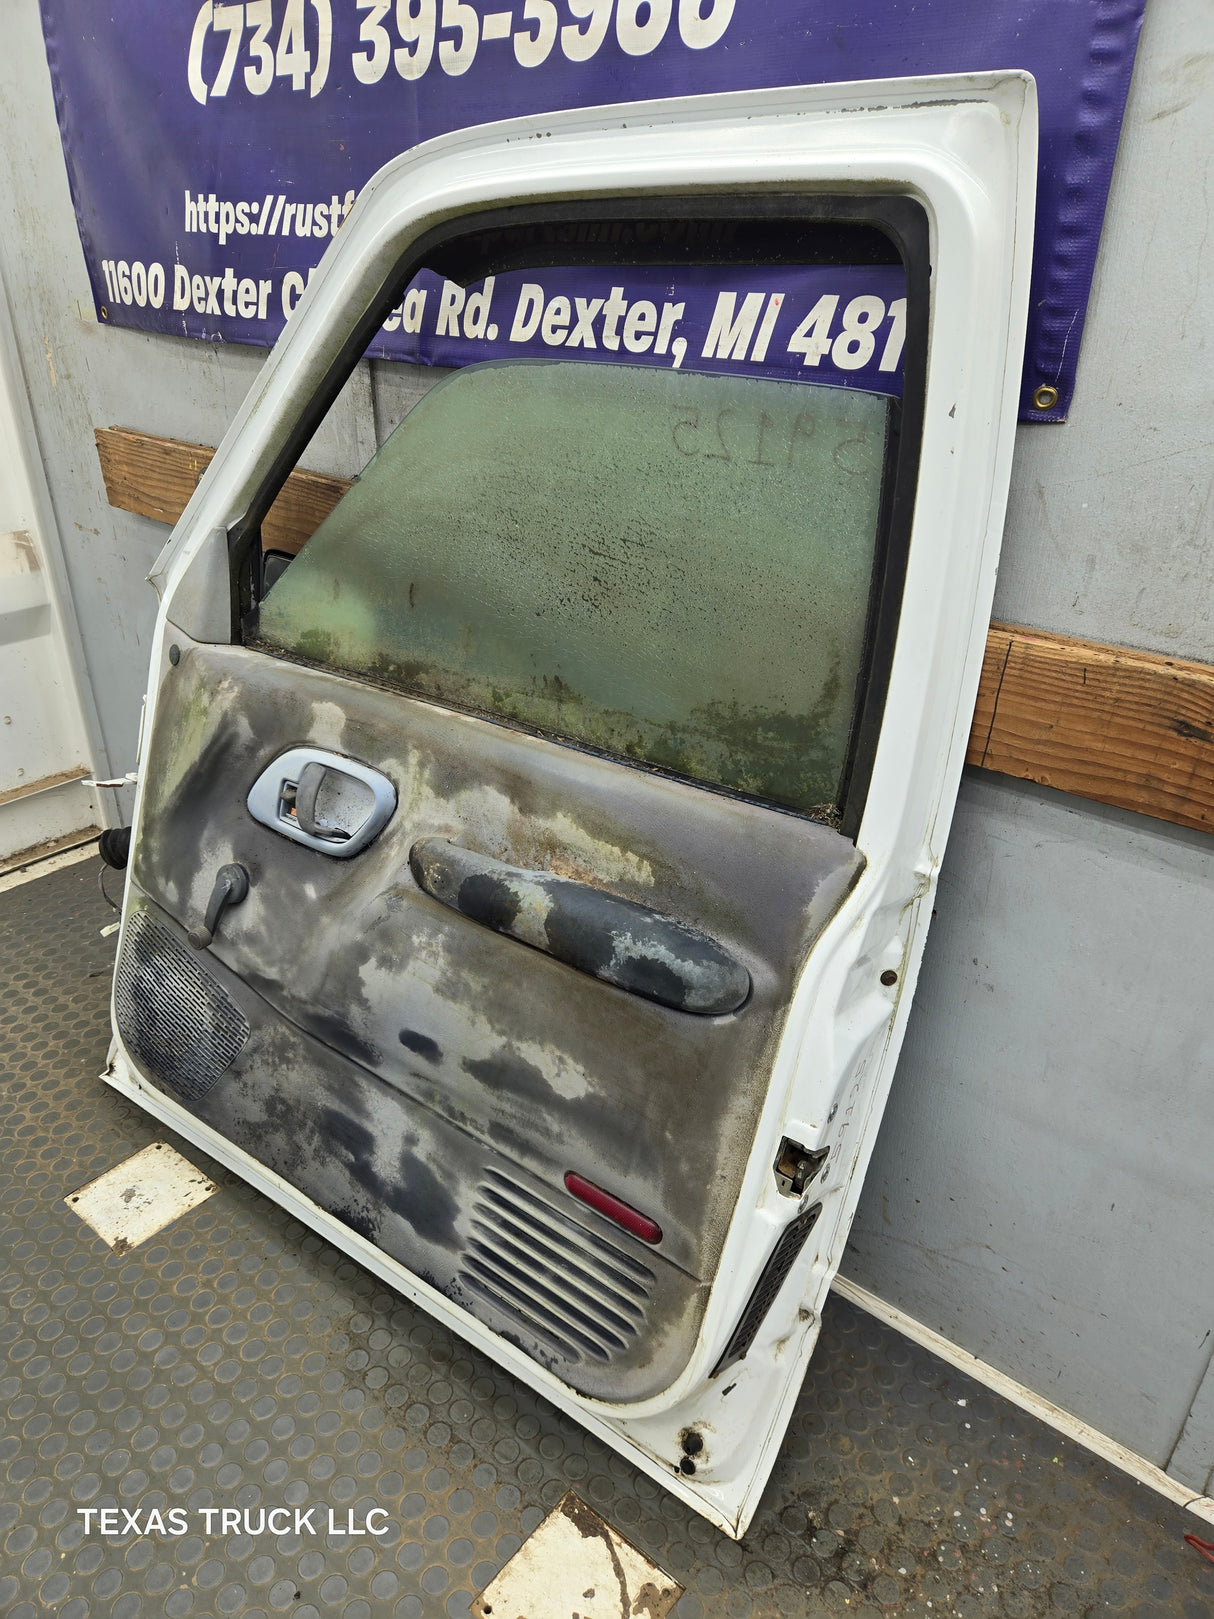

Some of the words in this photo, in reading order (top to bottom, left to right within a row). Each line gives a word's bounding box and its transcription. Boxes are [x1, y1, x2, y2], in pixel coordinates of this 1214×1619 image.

[187, 0, 332, 105] (734)
[101, 259, 165, 309] 11600
[173, 264, 272, 319] Dexter
[435, 275, 498, 341] Rd.
[509, 283, 687, 368] Dexter,
[701, 291, 785, 362] MI
